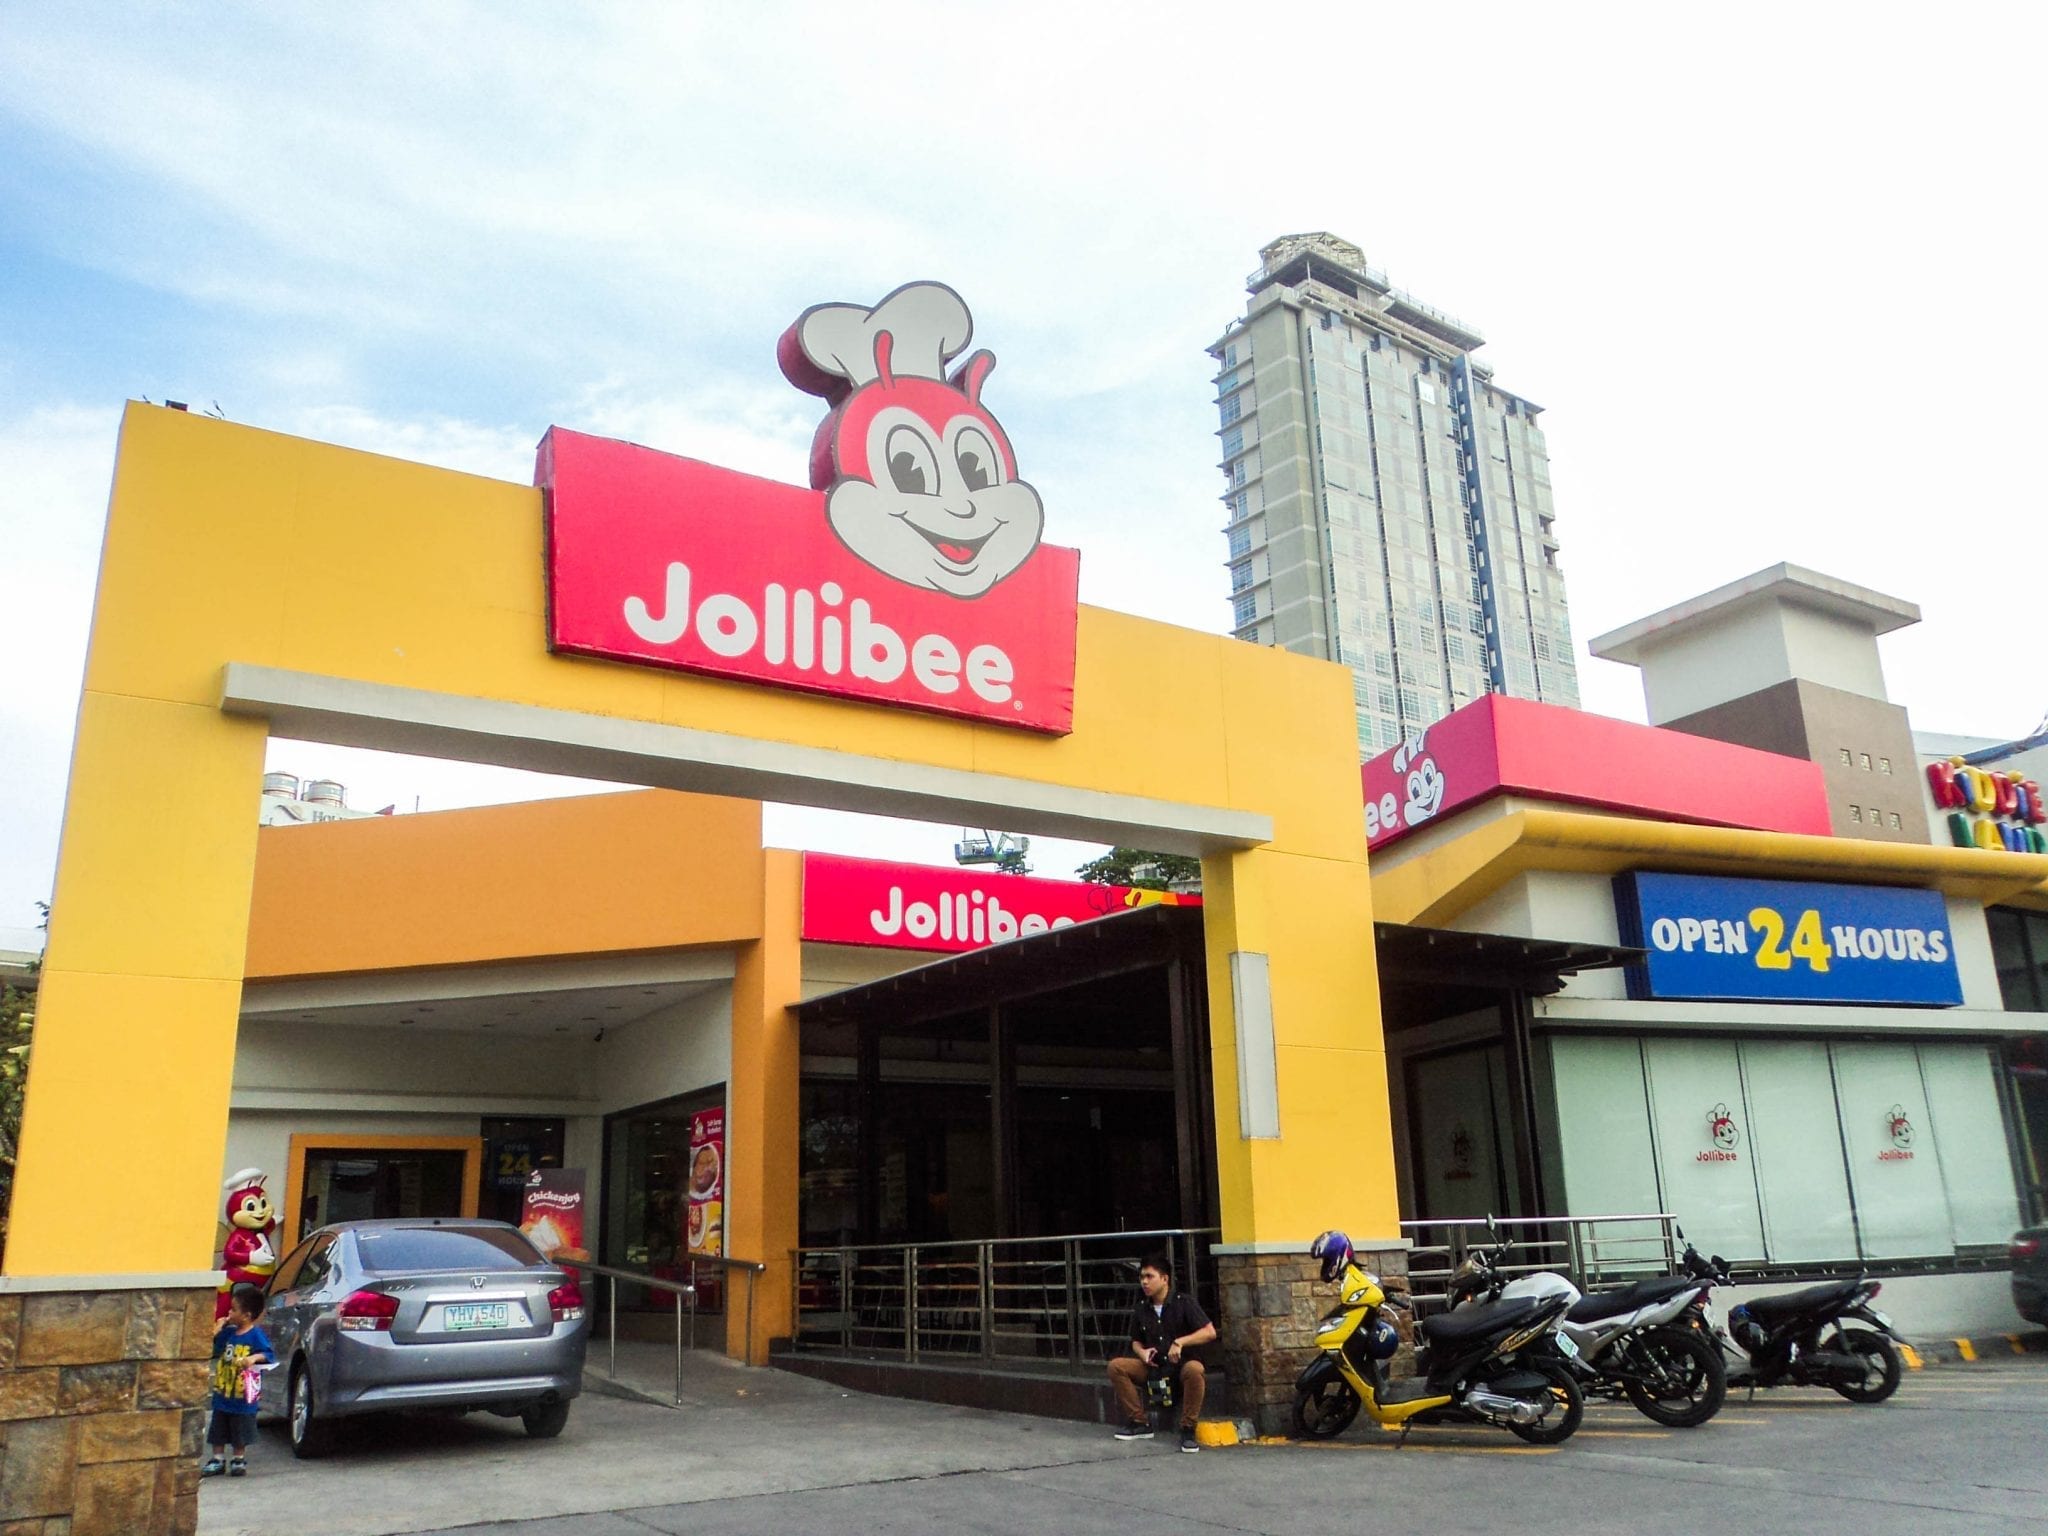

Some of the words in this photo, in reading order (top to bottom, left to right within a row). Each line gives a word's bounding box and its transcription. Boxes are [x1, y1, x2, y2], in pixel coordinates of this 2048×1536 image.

[624, 561, 1014, 703] Jollibee
[1651, 918, 1748, 954] OPEN
[1748, 907, 1832, 972] 24
[1831, 926, 1948, 962] HOURS
[1696, 1150, 1737, 1162] Jollibee
[1878, 1149, 1914, 1160] Jollibee
[527, 1191, 581, 1205] Chickenjoy
[449, 1307, 475, 1321] YHV
